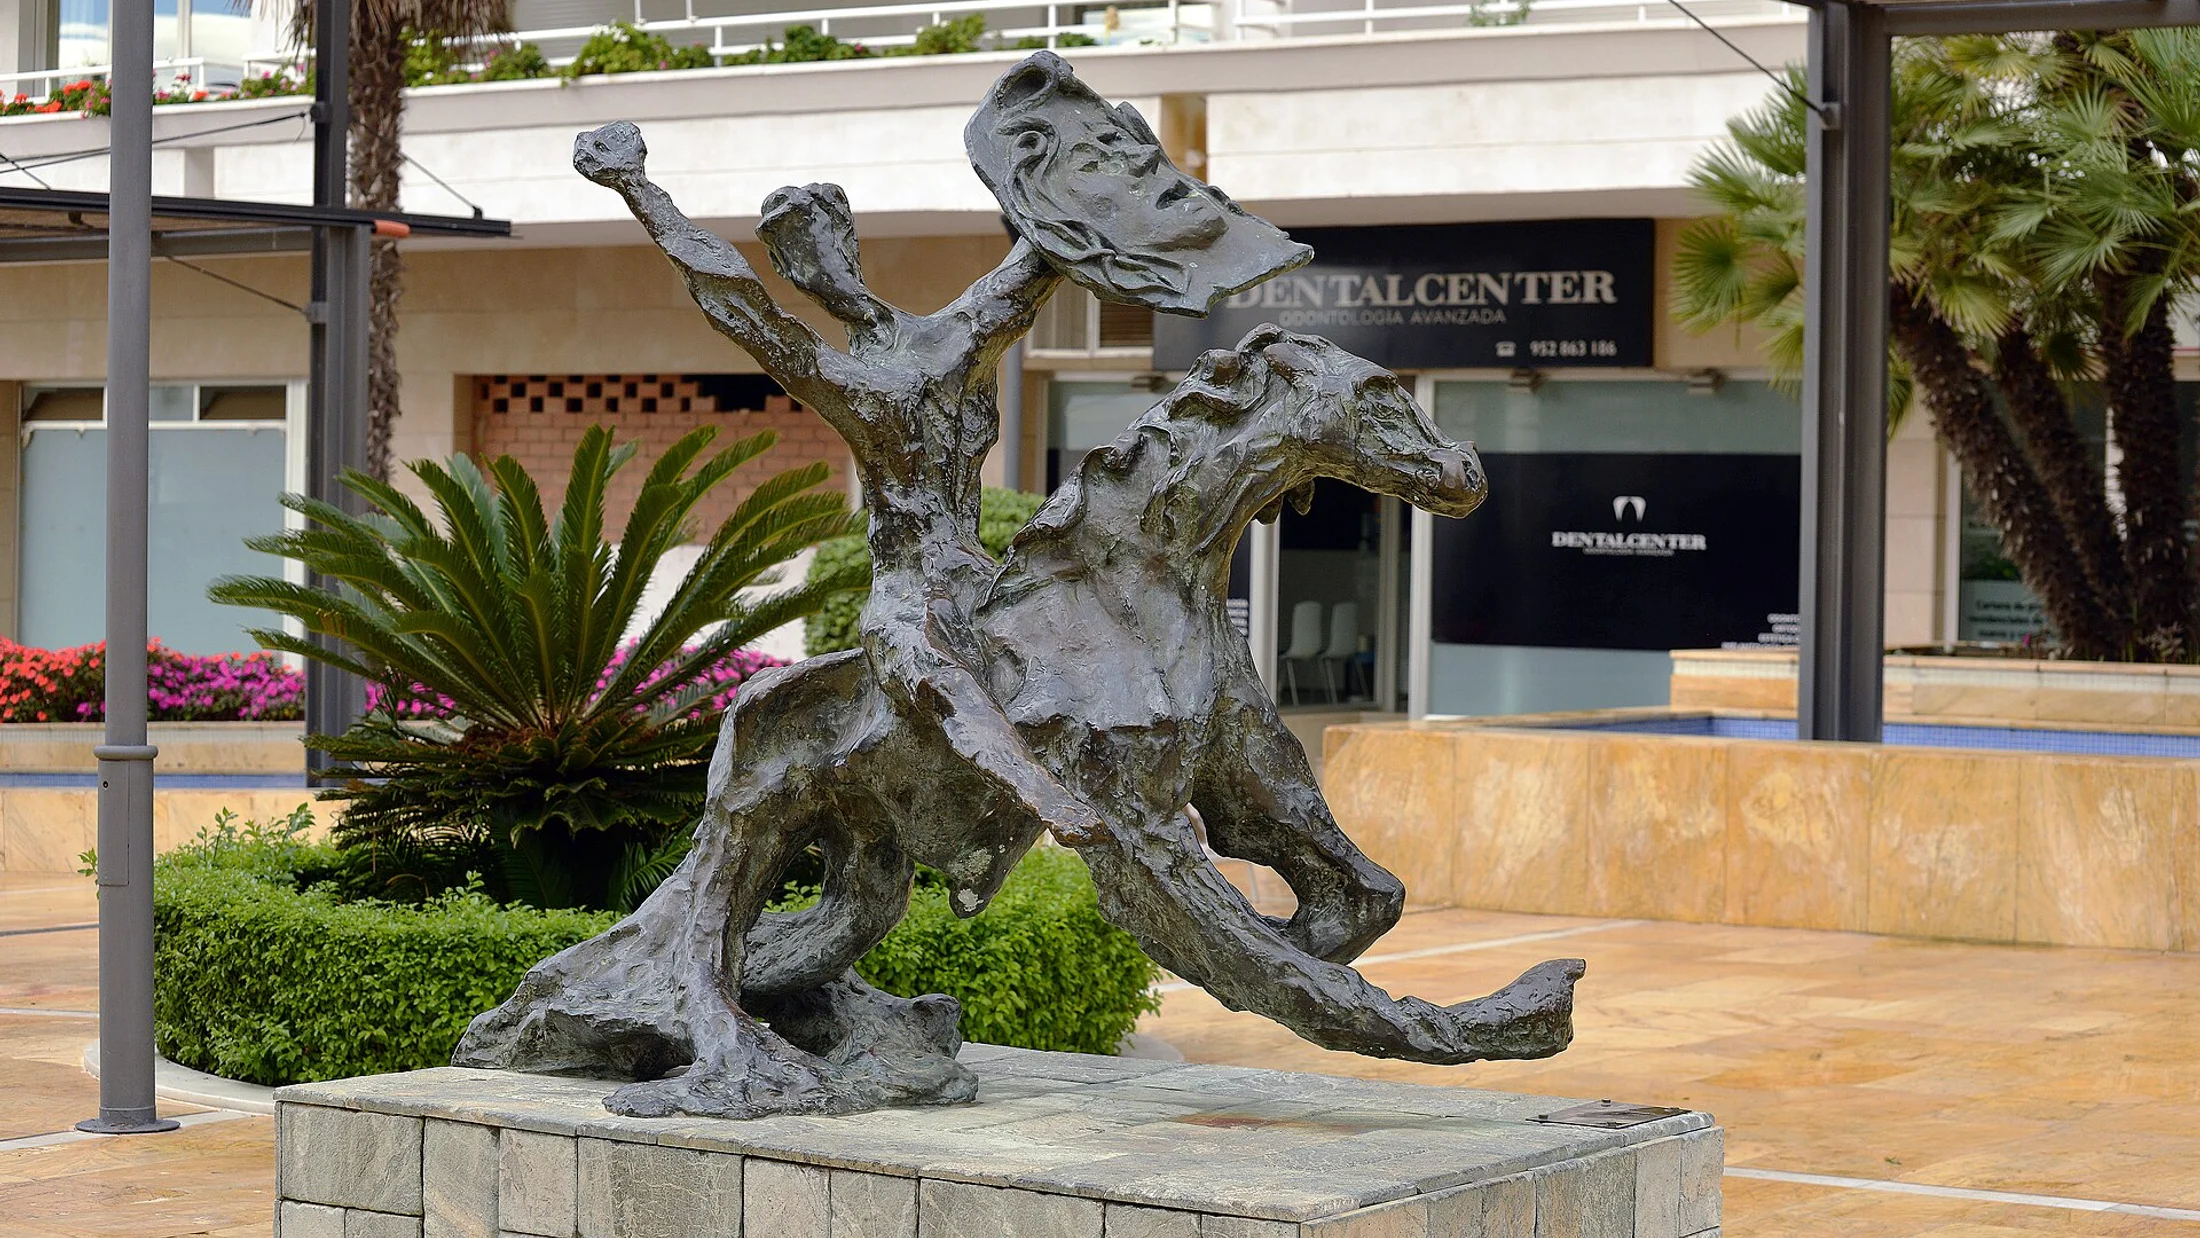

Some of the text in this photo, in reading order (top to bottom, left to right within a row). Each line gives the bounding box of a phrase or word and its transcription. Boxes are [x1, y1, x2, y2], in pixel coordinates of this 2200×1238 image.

[1410, 307, 1507, 325] AVANZADA
[1530, 339, 1618, 357] 952 863 186
[1552, 531, 1707, 551] DENTALCENTER
